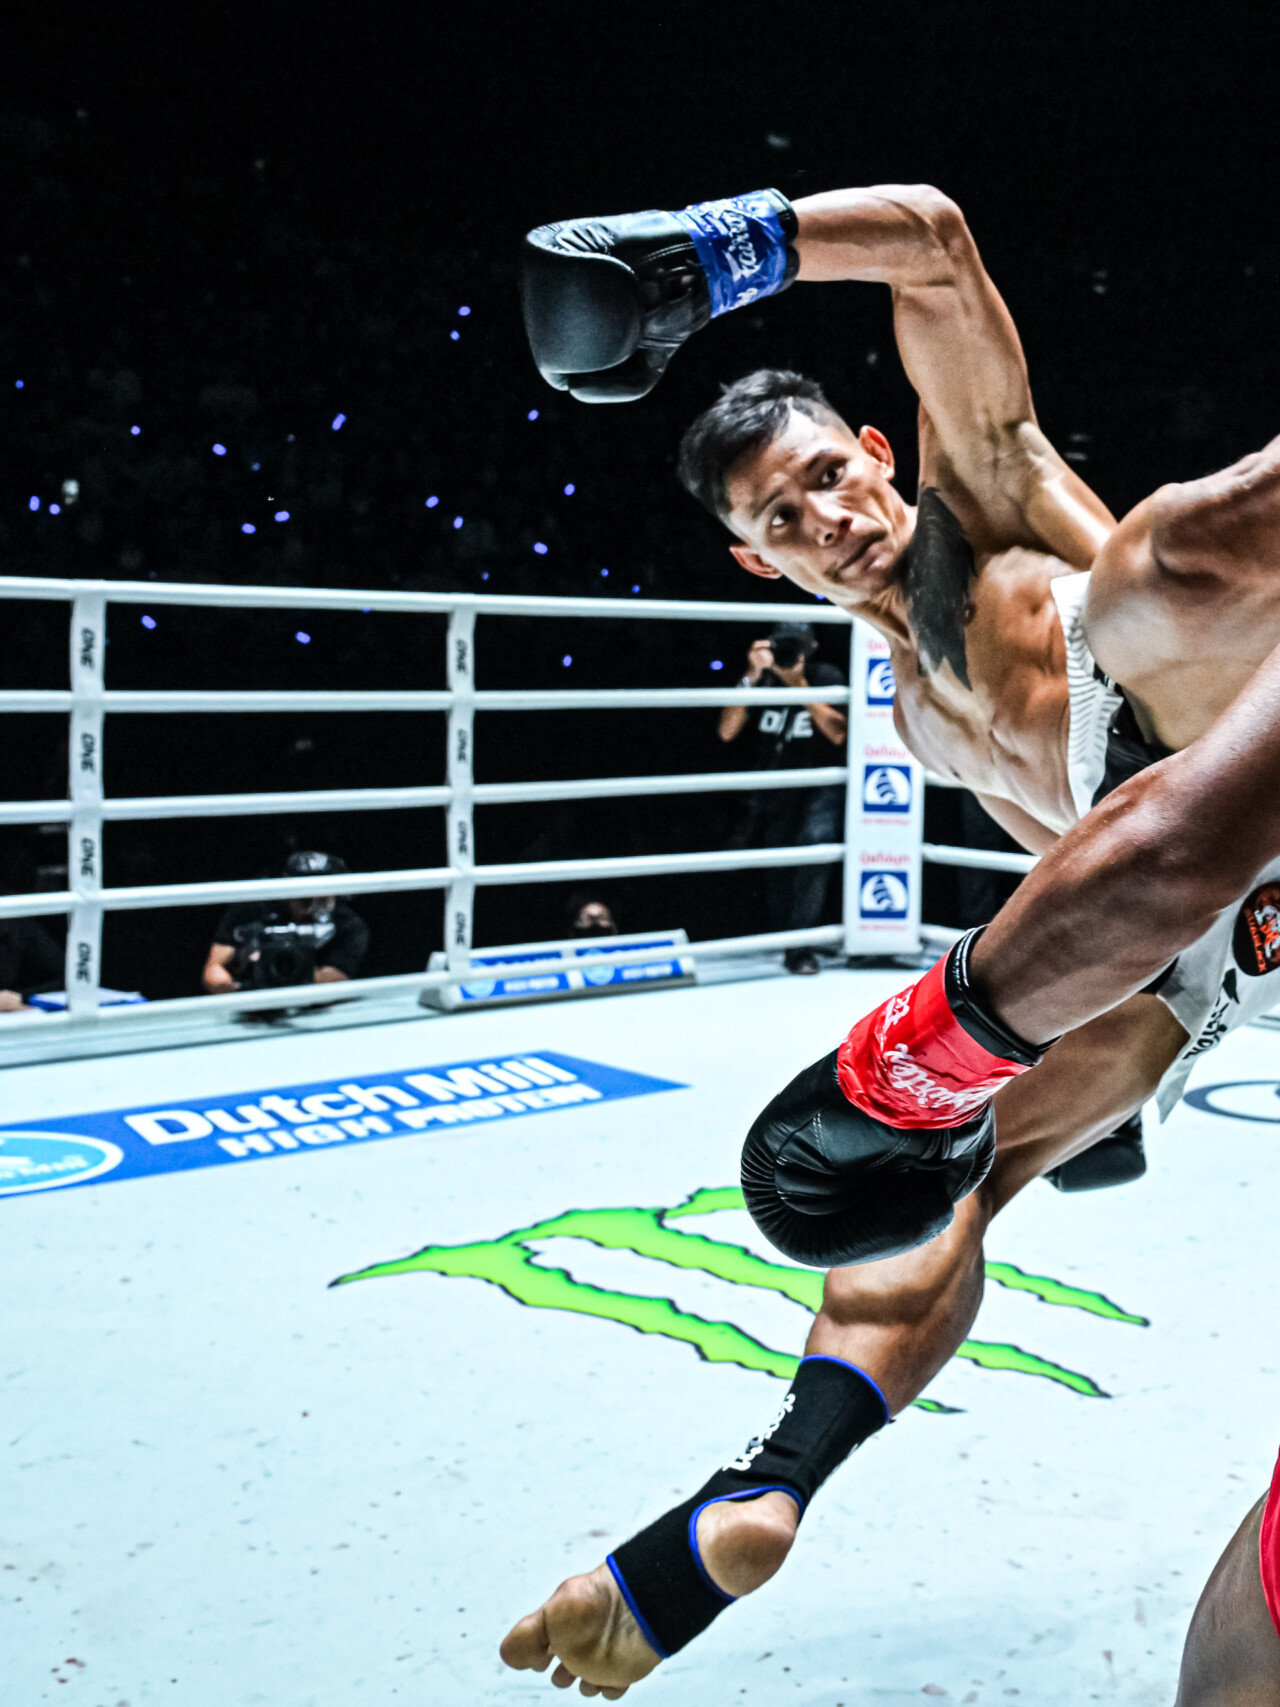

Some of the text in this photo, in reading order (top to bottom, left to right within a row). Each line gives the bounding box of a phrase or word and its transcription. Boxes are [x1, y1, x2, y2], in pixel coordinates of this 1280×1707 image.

[80, 627, 95, 669] ONE
[457, 639, 467, 672] ONE
[81, 733, 95, 772] ONE
[457, 729, 467, 762] ONE
[81, 837, 94, 877] ONE
[458, 822, 468, 854] ONE
[455, 912, 466, 945] ONE
[76, 942, 92, 983] ONE
[124, 1057, 577, 1145] Dutch Mill
[217, 1083, 603, 1157] HIGH PROTEIN
